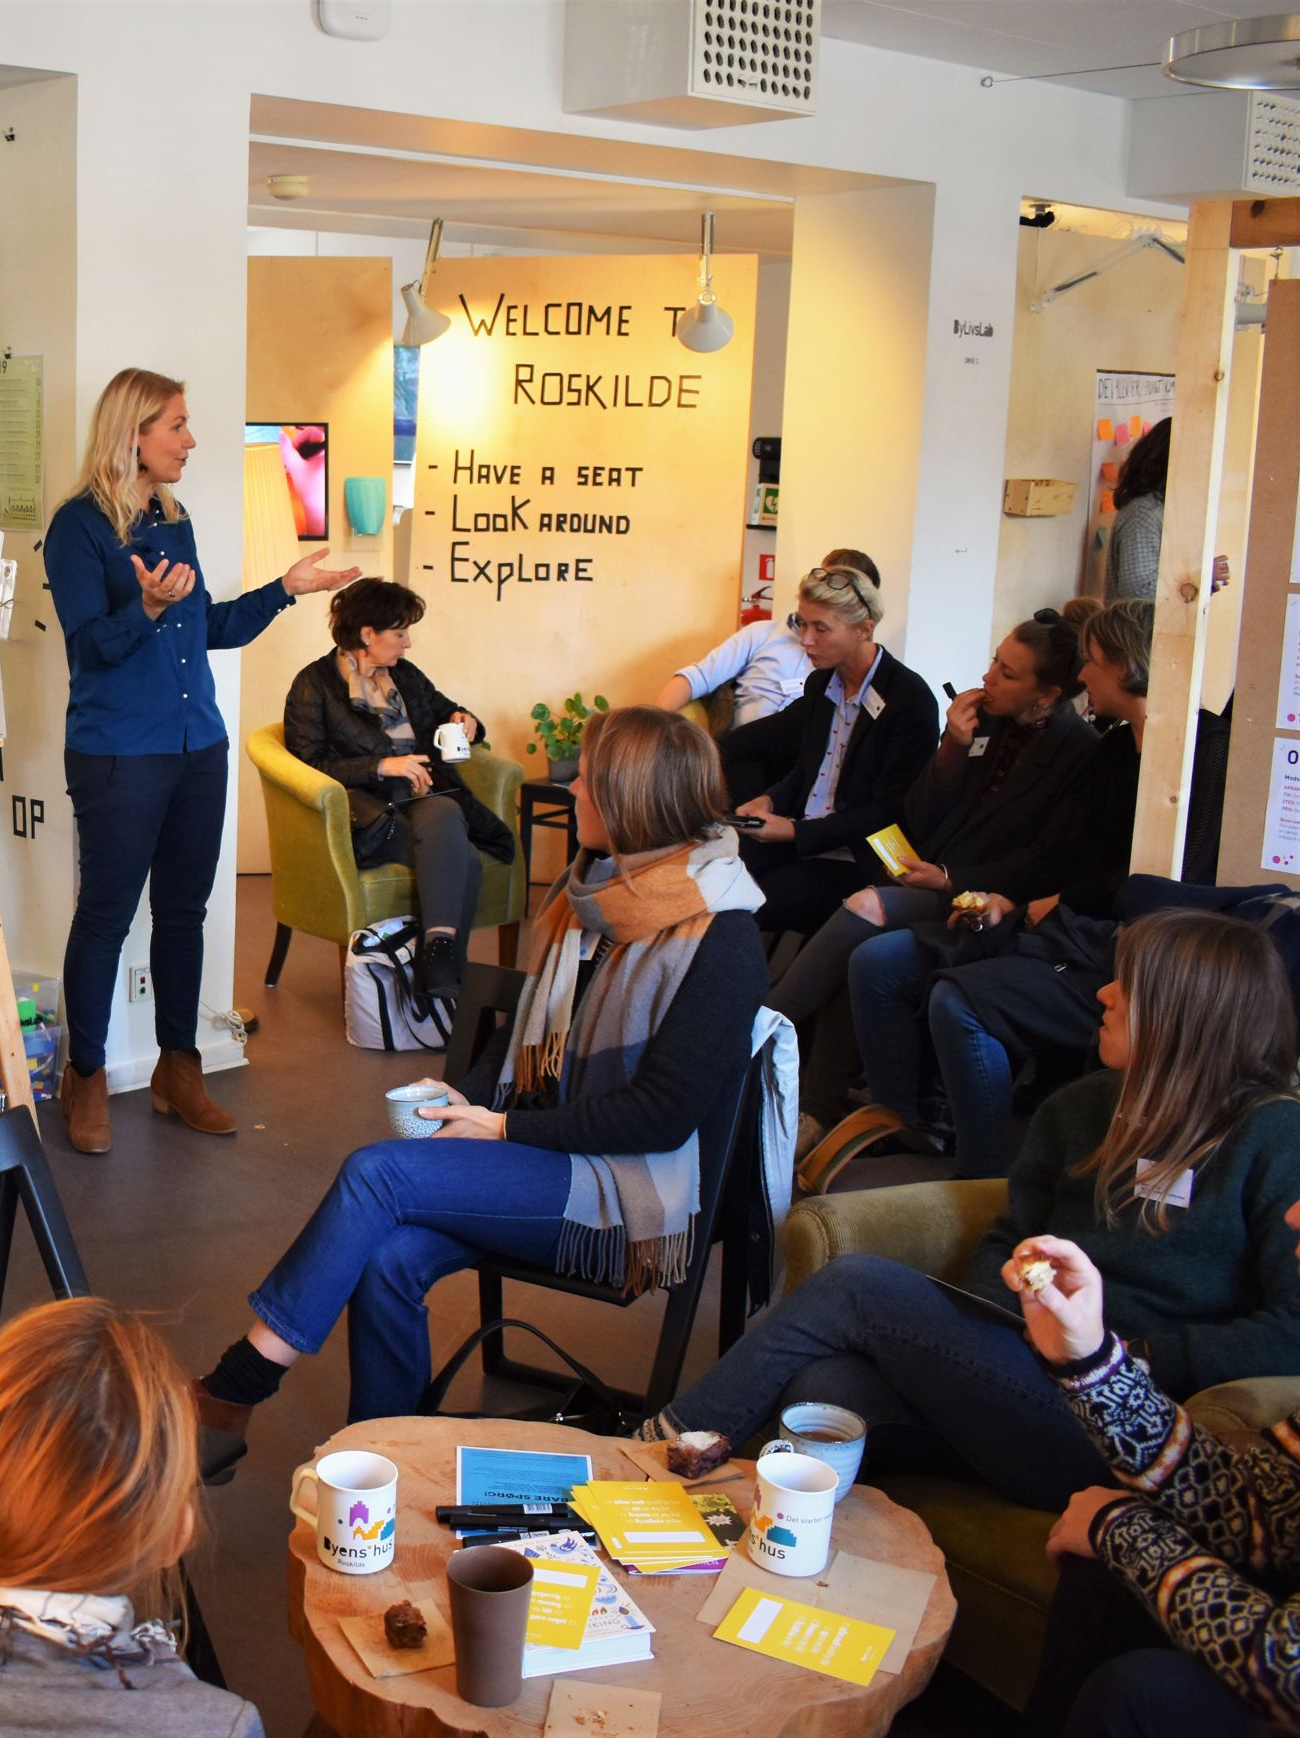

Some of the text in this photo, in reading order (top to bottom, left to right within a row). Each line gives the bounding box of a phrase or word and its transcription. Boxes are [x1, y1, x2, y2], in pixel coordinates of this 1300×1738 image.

[459, 293, 686, 337] WELCOME T
[953, 319, 993, 338] ByLivsLab
[514, 364, 702, 410] ROSKILDE
[453, 449, 521, 484] HAVE
[541, 466, 555, 485] A
[577, 466, 643, 487] SEAT
[539, 513, 630, 535] AROUND
[12, 795, 45, 840] OP
[484, 1491, 531, 1500] SPØRG!
[786, 1515, 799, 1523] Det
[323, 1536, 393, 1559] Byens hus
[759, 1538, 786, 1560] hus
[337, 1559, 366, 1568] Roskilde
[588, 1619, 621, 1629] IKING
